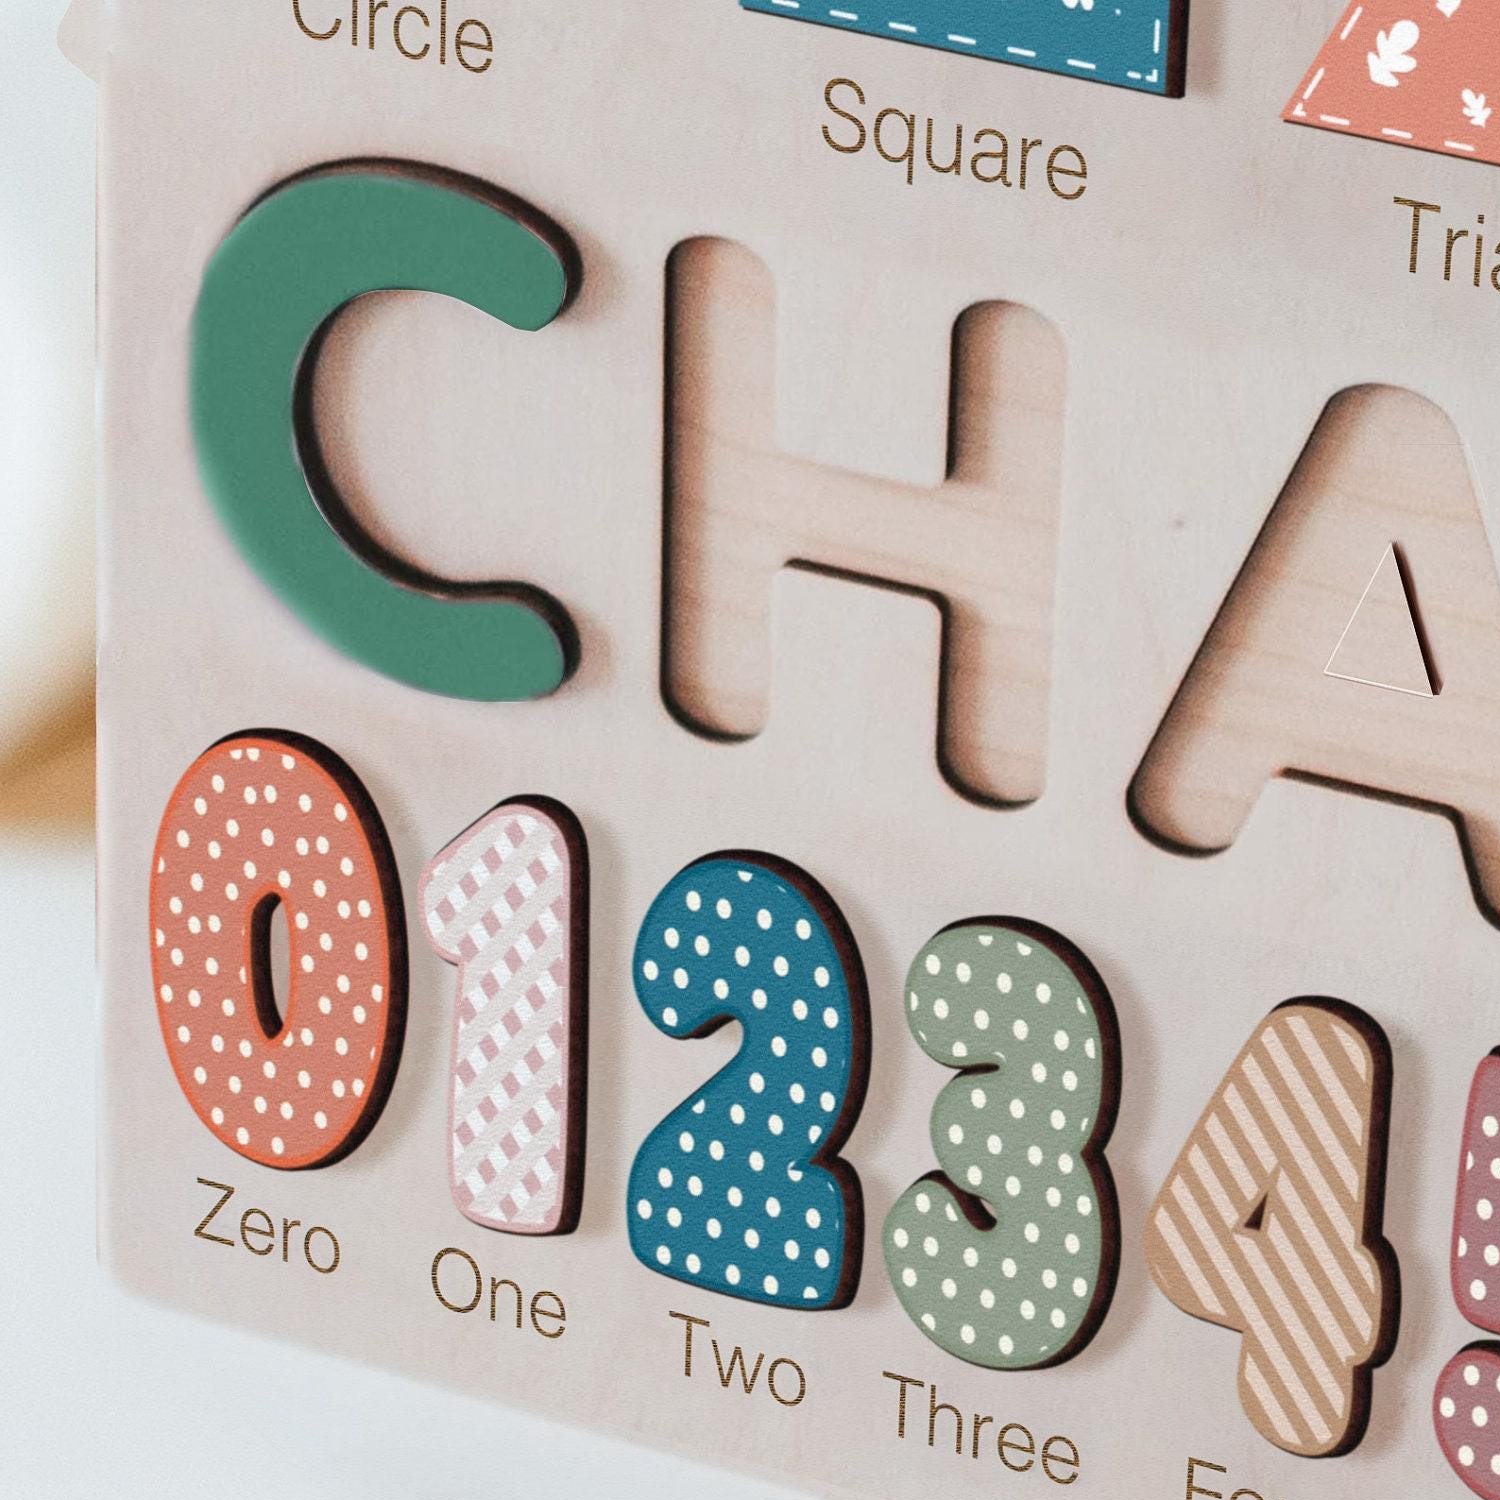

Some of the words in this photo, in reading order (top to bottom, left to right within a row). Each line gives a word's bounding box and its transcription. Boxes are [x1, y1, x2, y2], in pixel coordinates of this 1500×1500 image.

[821, 77, 1088, 201] Square
[149, 728, 409, 1171] 0
[419, 793, 589, 1236] 1
[627, 849, 872, 1311] 2
[882, 914, 1122, 1371] 3
[1144, 995, 1402, 1458] 4
[194, 1178, 341, 1274] Zero
[430, 1247, 567, 1339] One
[668, 1310, 807, 1407] Two
[882, 1371, 1080, 1485] Three
